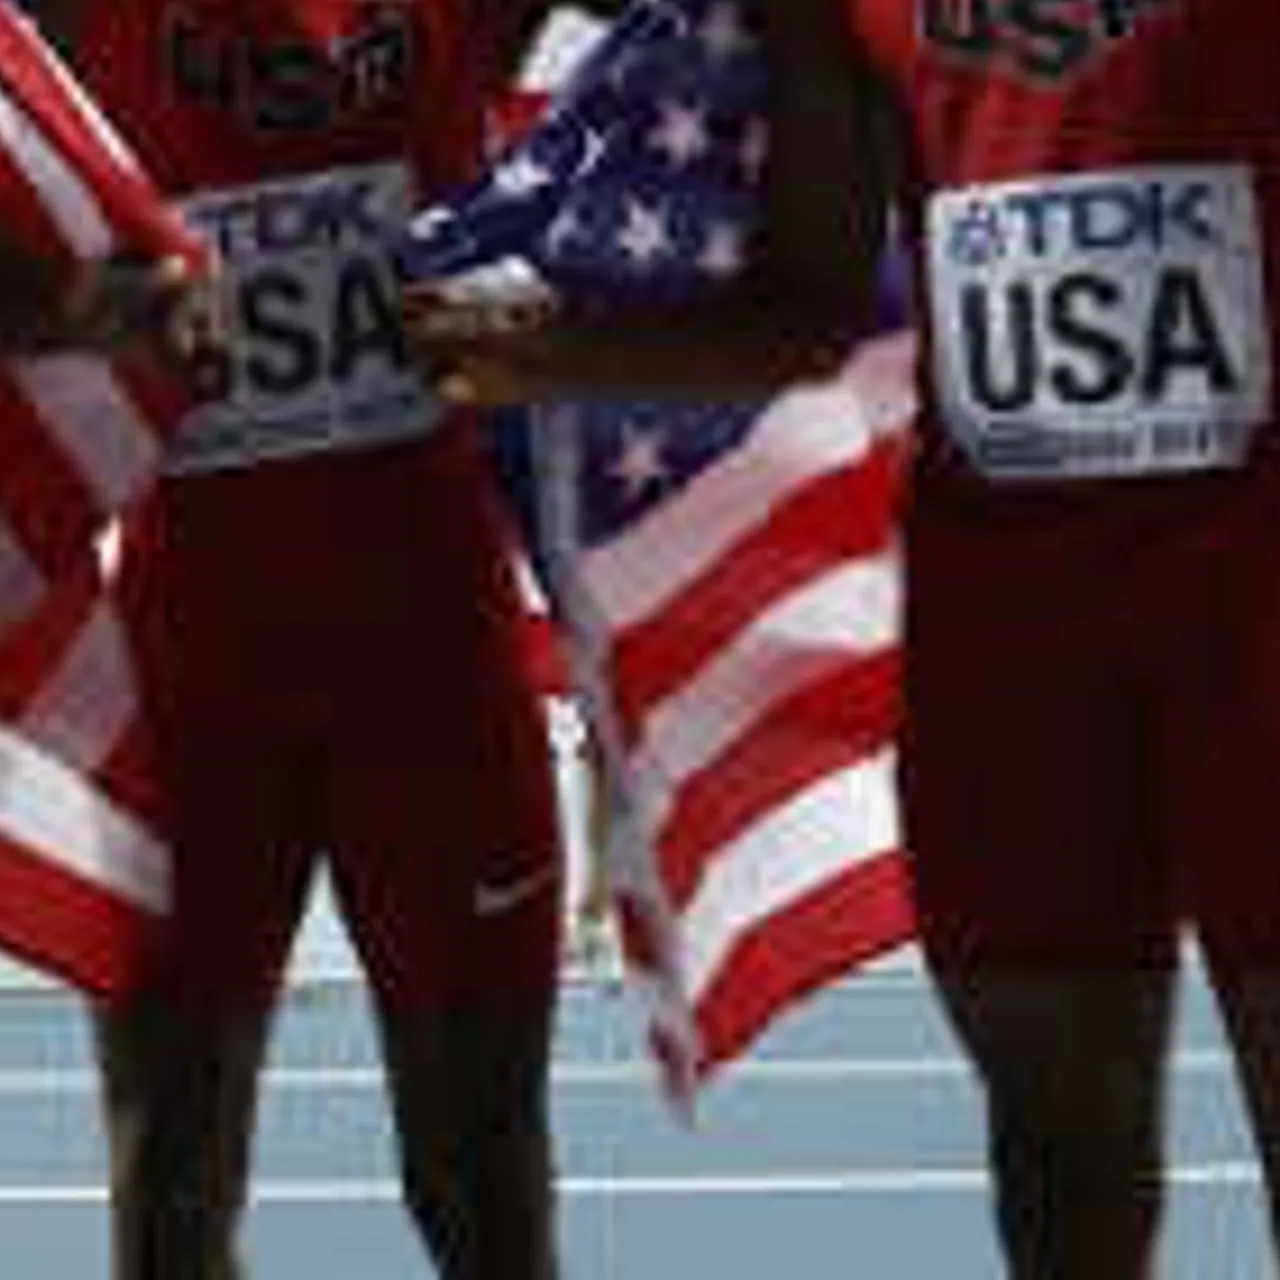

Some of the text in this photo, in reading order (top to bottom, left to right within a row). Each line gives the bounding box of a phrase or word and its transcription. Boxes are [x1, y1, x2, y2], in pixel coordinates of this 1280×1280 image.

[184, 180, 384, 258] TDK
[1006, 182, 1214, 258] TDK
[210, 258, 412, 402] SA
[960, 267, 1238, 412] USA
